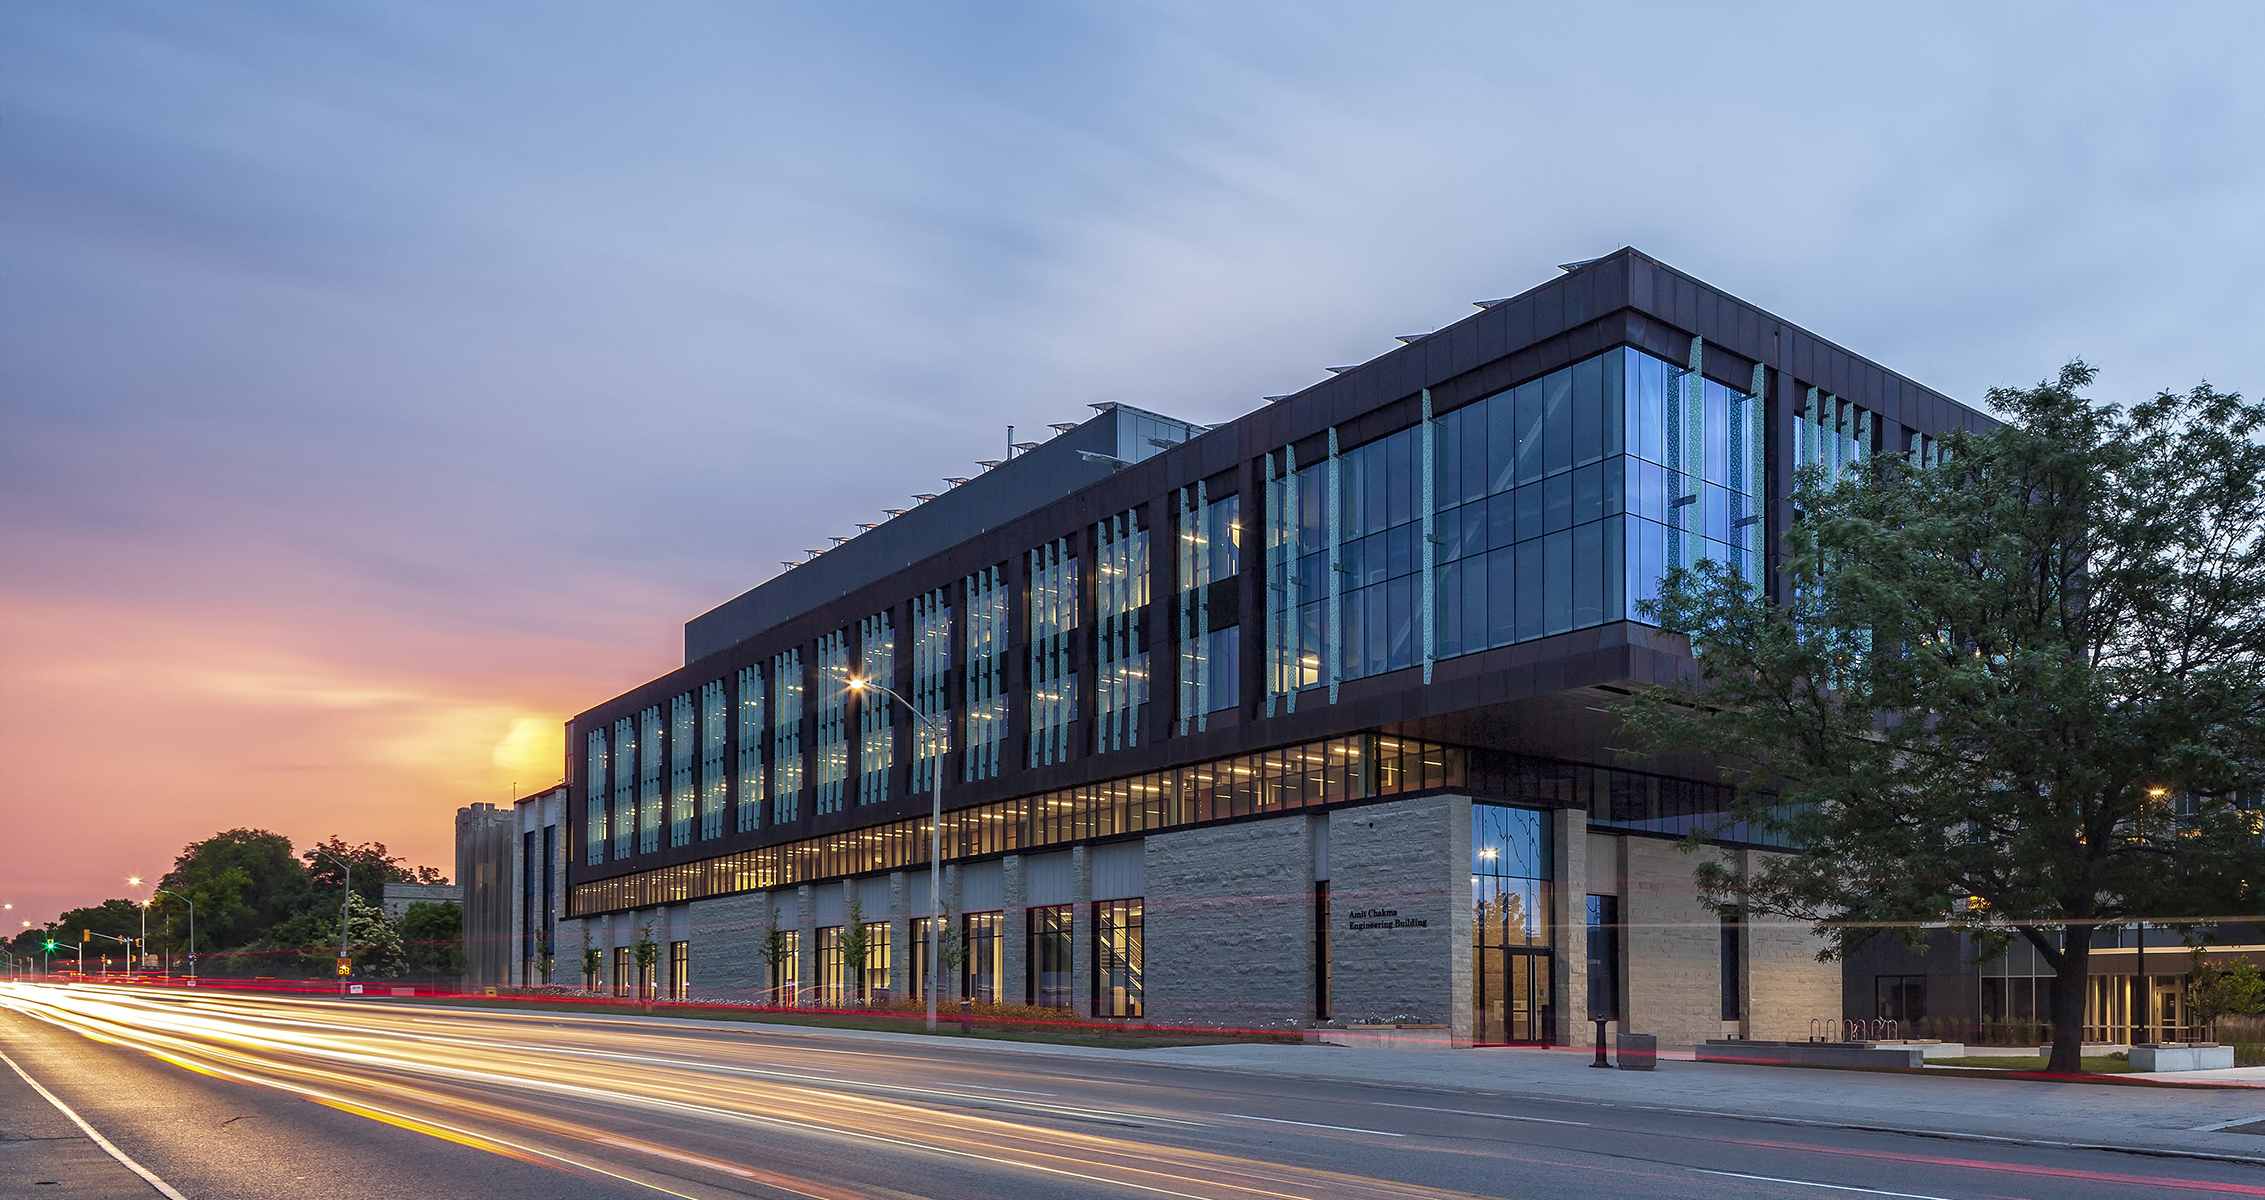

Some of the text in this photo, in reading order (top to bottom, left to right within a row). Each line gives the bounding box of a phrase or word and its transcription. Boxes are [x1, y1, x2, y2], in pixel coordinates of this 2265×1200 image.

[1349, 908, 1397, 918] Amit Chakma
[1349, 918, 1427, 930] Engineering Building
